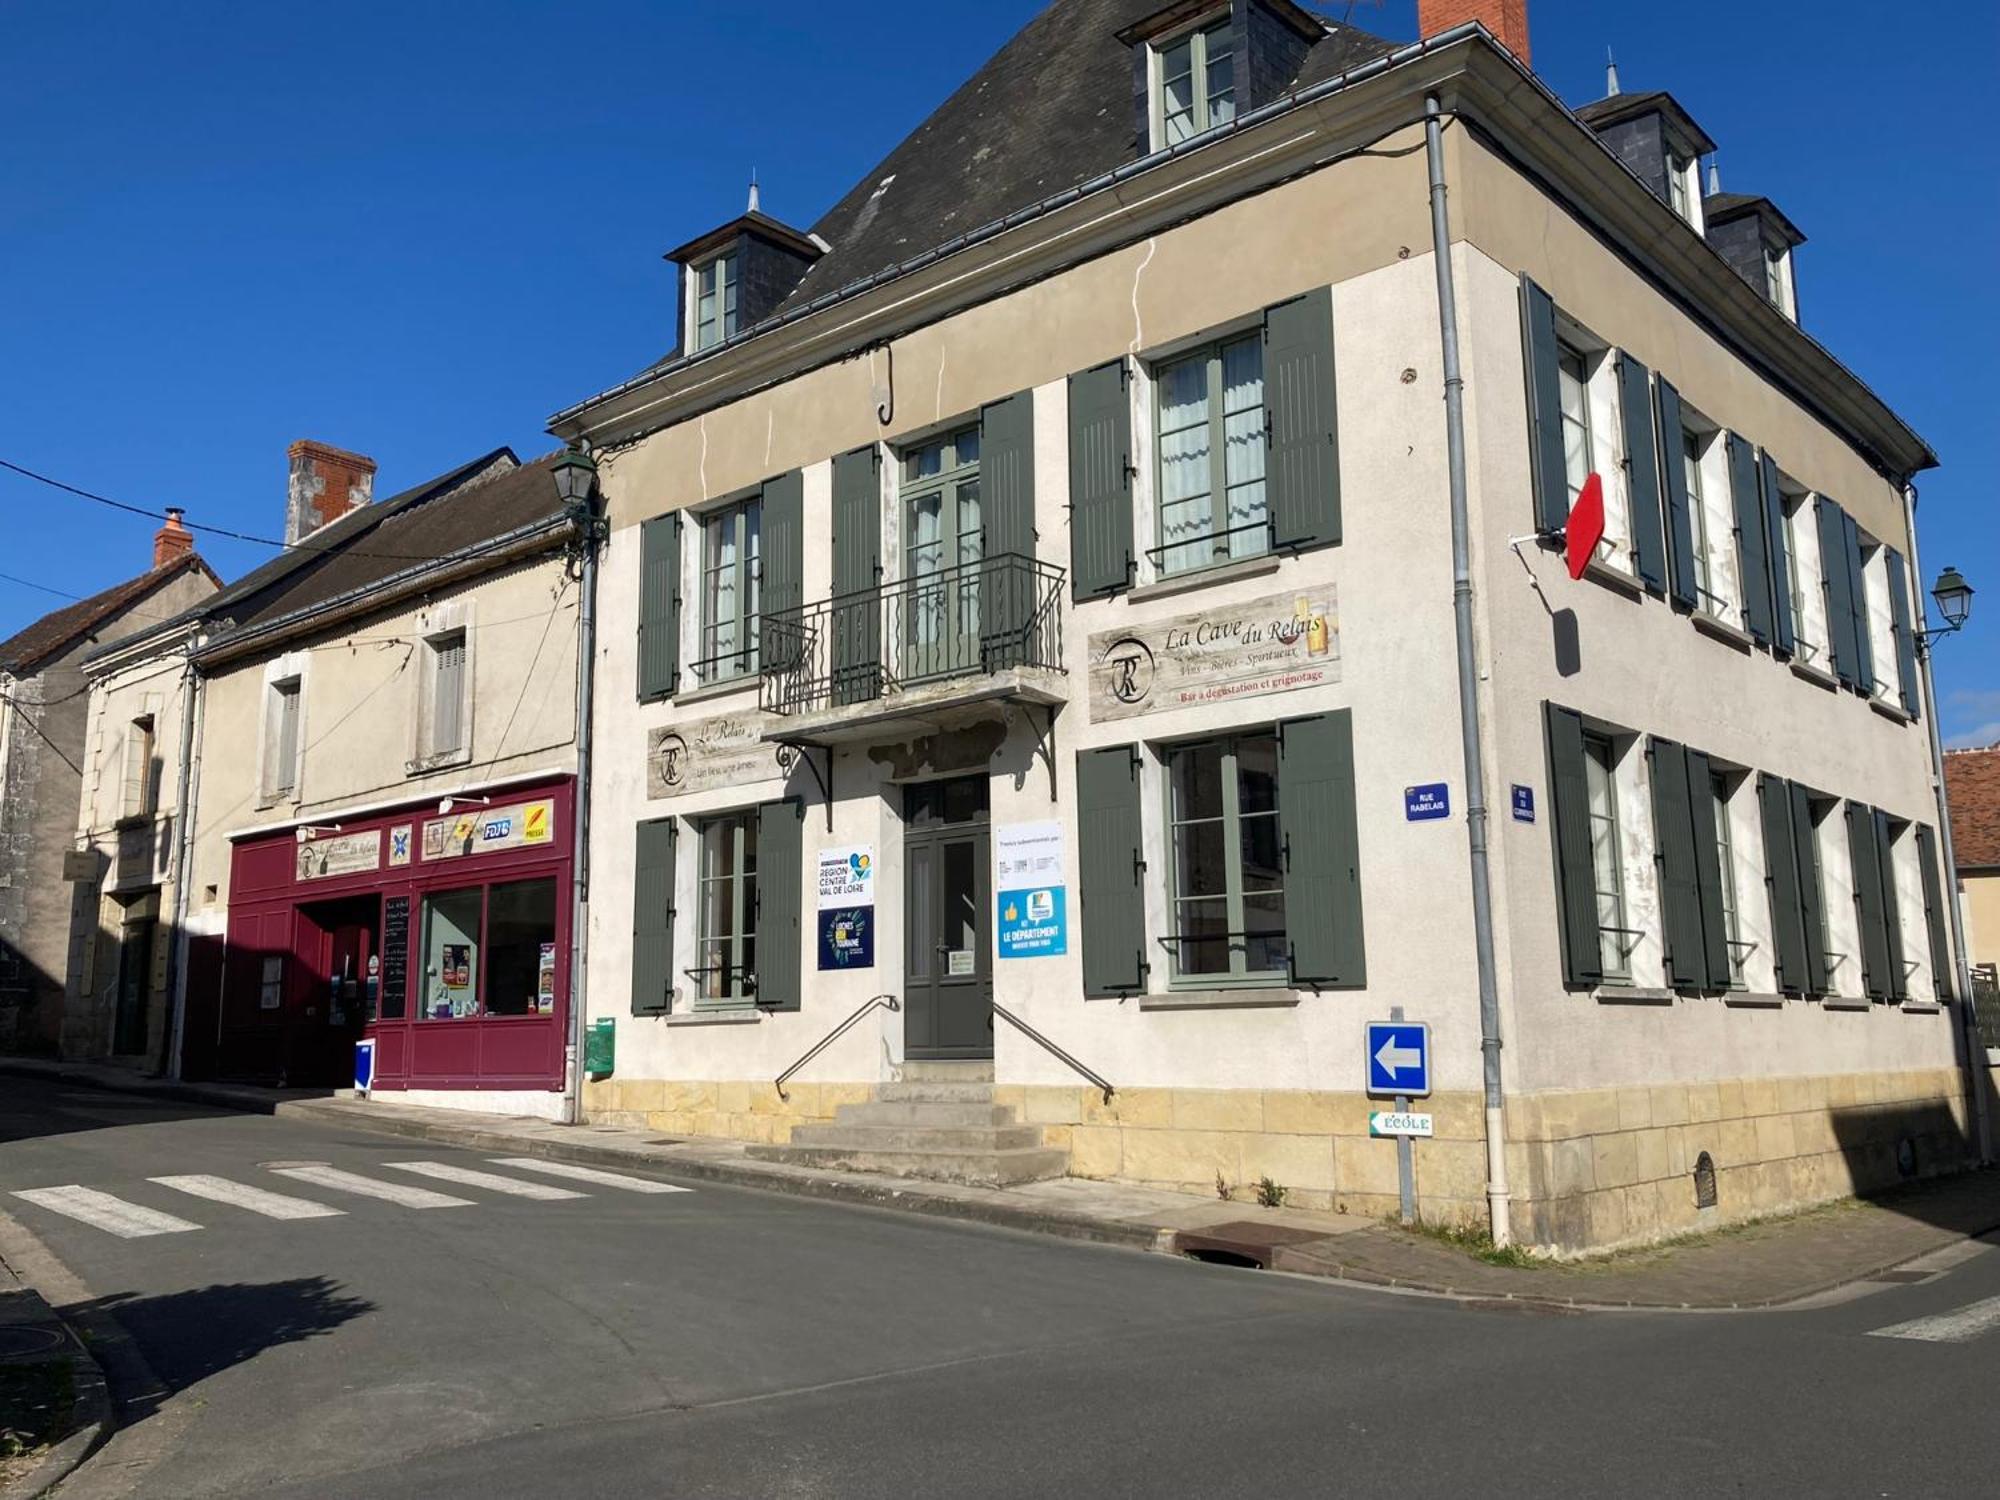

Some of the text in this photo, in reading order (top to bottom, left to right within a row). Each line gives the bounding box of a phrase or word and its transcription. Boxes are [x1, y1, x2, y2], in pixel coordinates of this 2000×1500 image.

[1165, 614, 1320, 650] La Cave du Relais
[1180, 693, 1196, 702] Bar
[1260, 680, 1270, 688] et
[1272, 670, 1323, 687] grignotage
[1420, 793, 1434, 802] RUE
[1410, 802, 1444, 812] RABELAIS
[484, 824, 501, 838] FDJ
[820, 876, 847, 886] CENTRE
[820, 884, 864, 896] VAL DE LOIRE
[1004, 926, 1058, 942] LE DÉPARTEMENT
